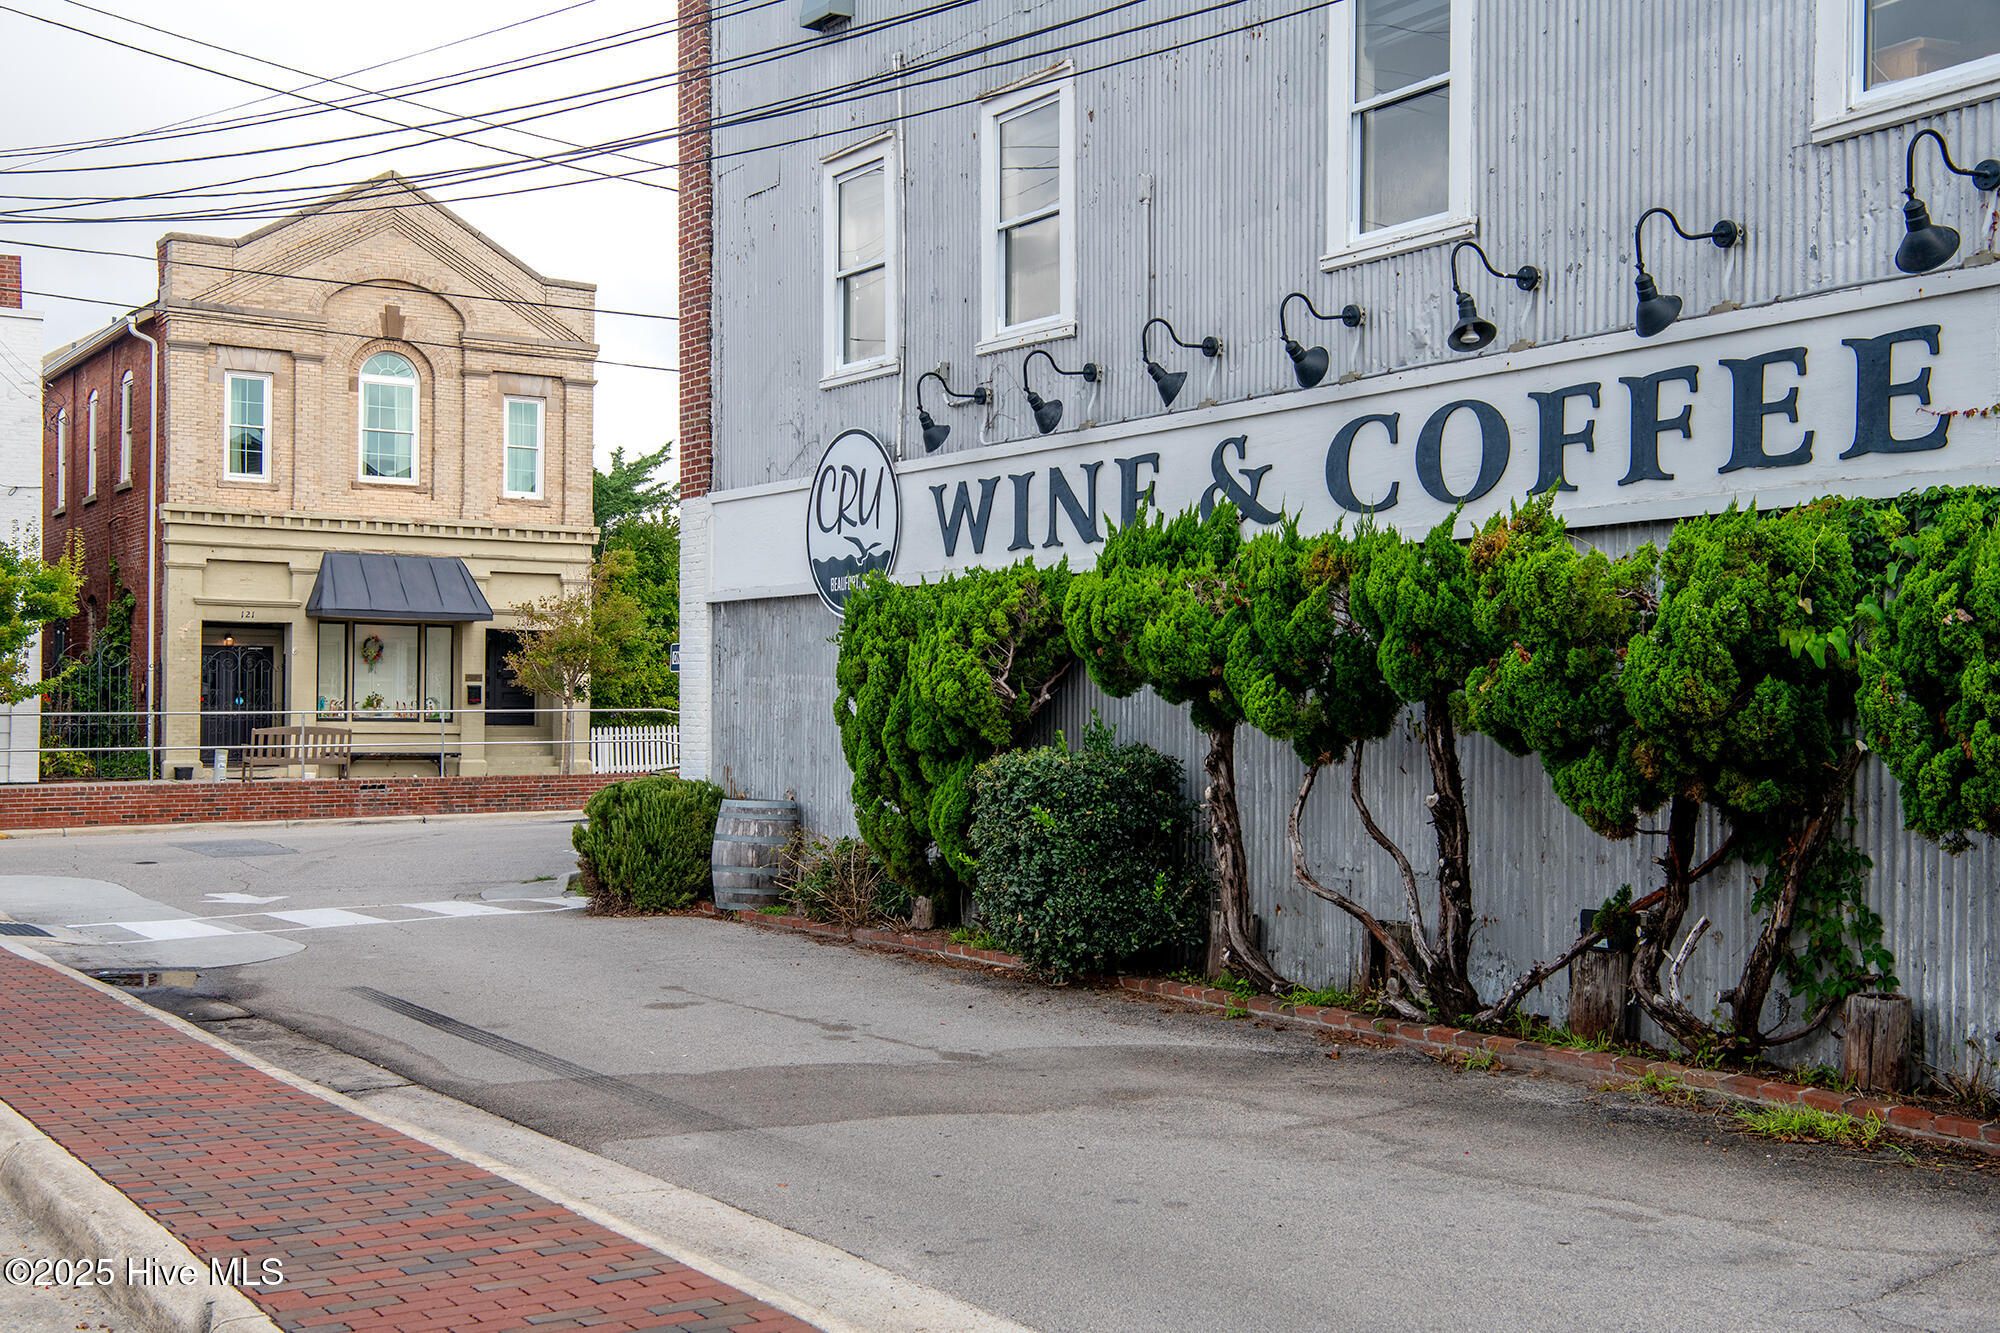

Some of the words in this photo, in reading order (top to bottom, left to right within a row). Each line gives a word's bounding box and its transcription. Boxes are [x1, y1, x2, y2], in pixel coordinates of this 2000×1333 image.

[929, 452, 1164, 557] WINE
[1200, 434, 1282, 525] &
[1325, 323, 1952, 513] COFFEE
[816, 464, 884, 534] CRU
[241, 610, 255, 619] 121
